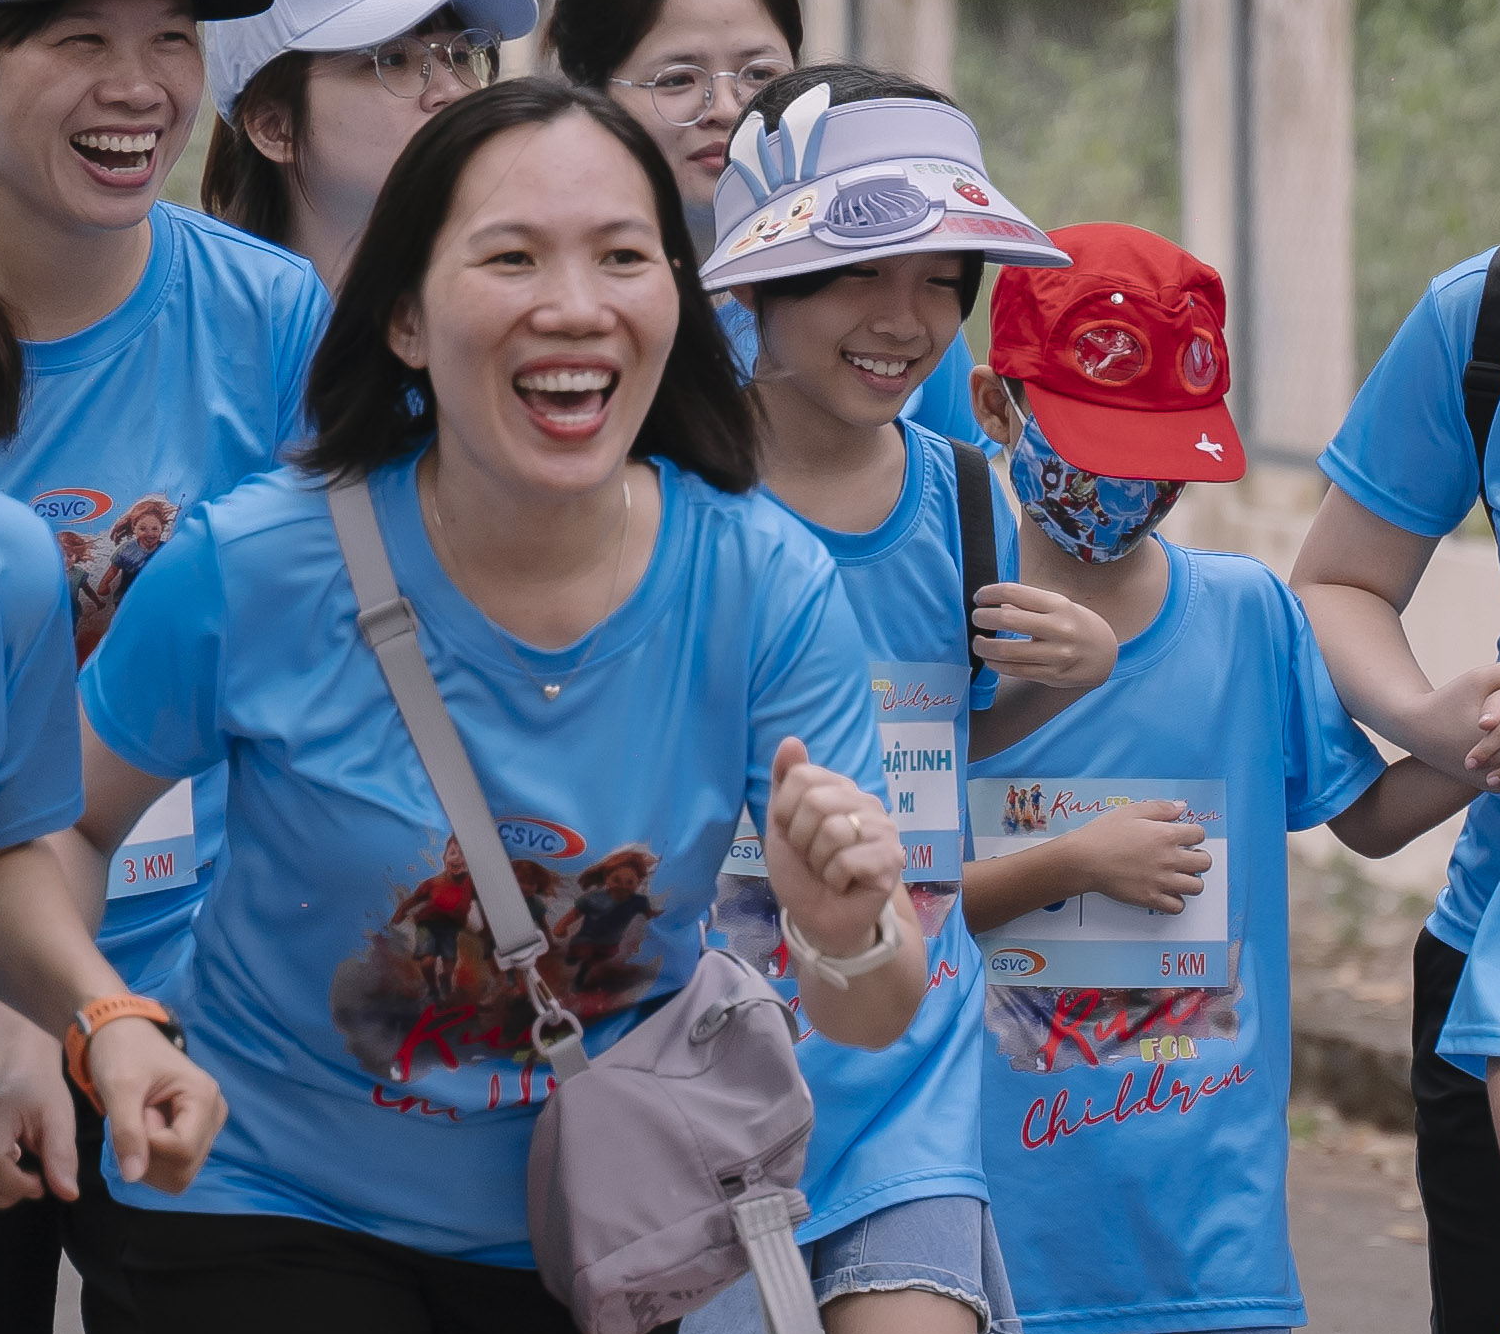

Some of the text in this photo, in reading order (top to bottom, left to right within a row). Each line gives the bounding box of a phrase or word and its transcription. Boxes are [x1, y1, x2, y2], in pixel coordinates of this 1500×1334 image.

[912, 163, 977, 182] FRUIT
[34, 501, 87, 520] CSVC
[882, 740, 953, 781] HẬT LINH
[899, 791, 915, 814] M1
[1050, 789, 1110, 820] Run
[499, 824, 560, 853] CSVC
[730, 844, 764, 861] CSV
[911, 844, 933, 870] KM
[123, 853, 175, 885] 3 KM
[991, 952, 1206, 976] CSVC 5 KM
[1038, 988, 1212, 1069] Run
[1020, 1063, 1255, 1149] Children
